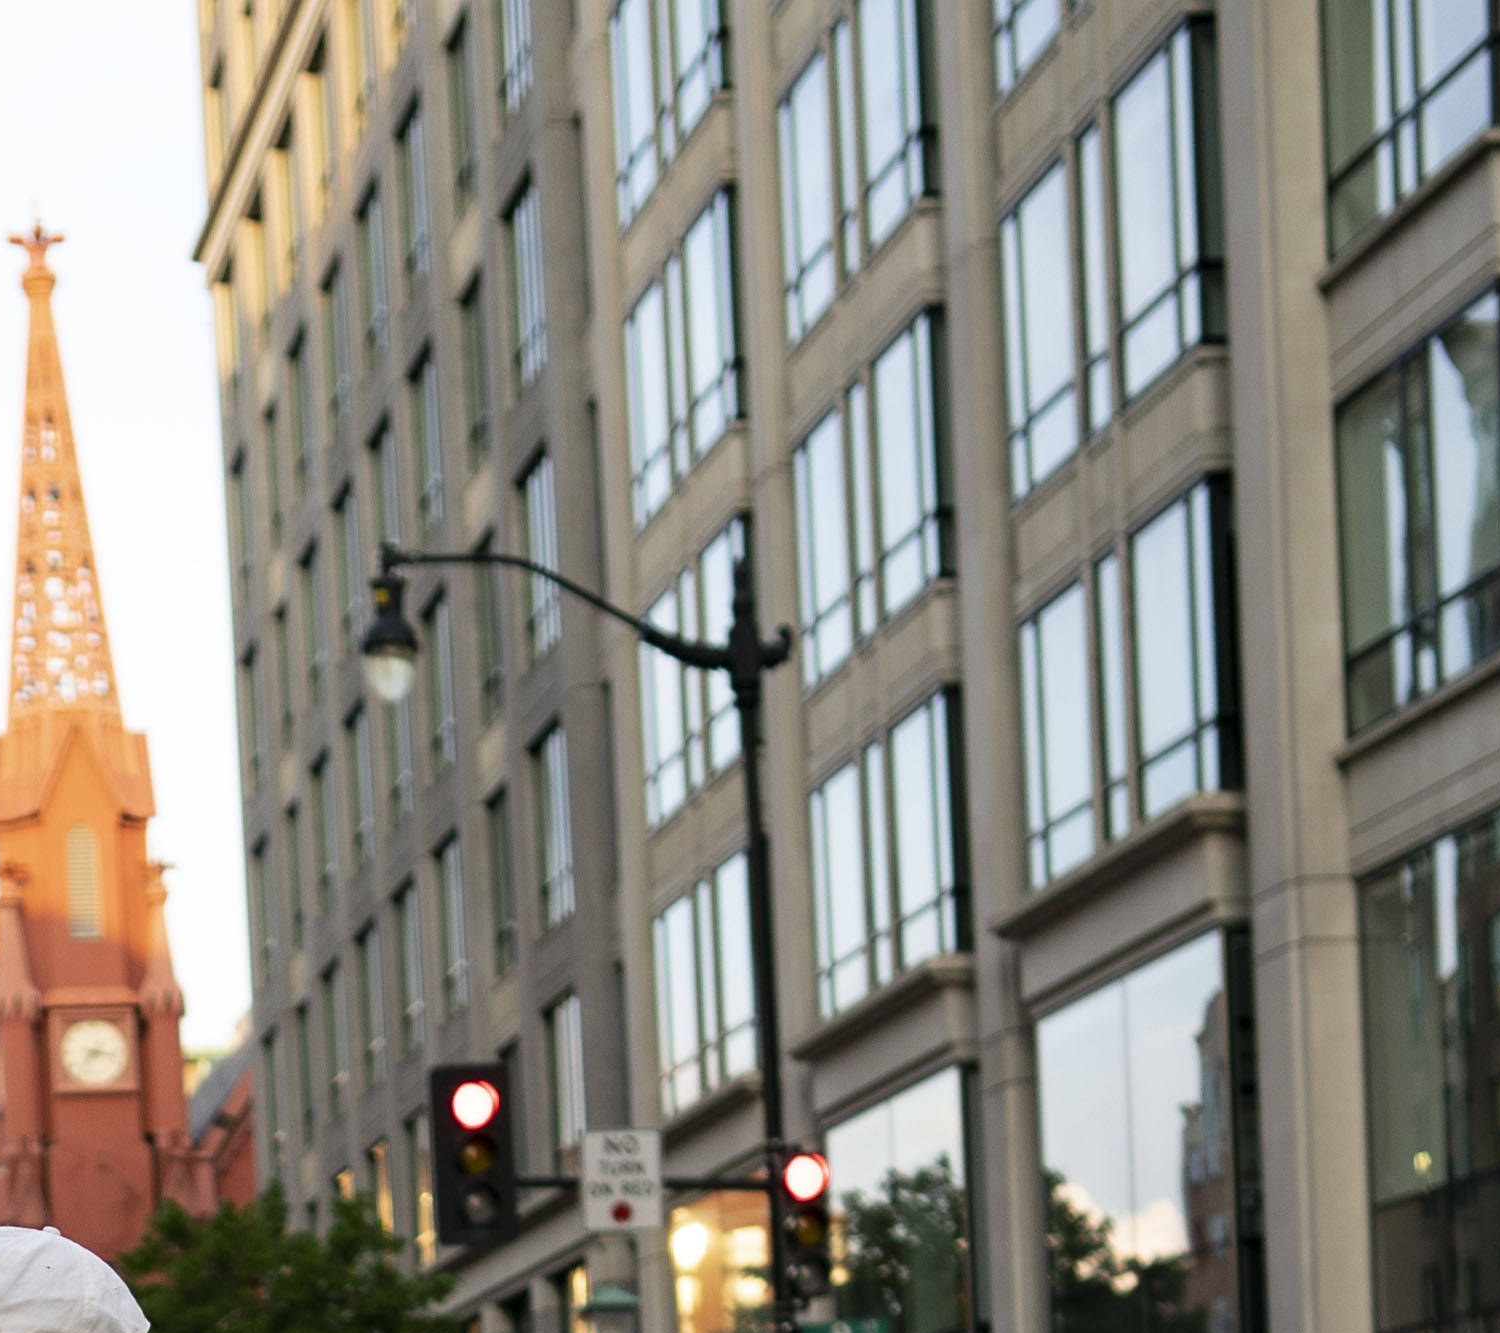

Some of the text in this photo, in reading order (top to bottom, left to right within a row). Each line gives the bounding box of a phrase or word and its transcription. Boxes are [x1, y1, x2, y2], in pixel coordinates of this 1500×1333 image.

[603, 1134, 639, 1154] NO
[599, 1160, 645, 1175] TURN
[590, 1178, 653, 1196] ON RED
